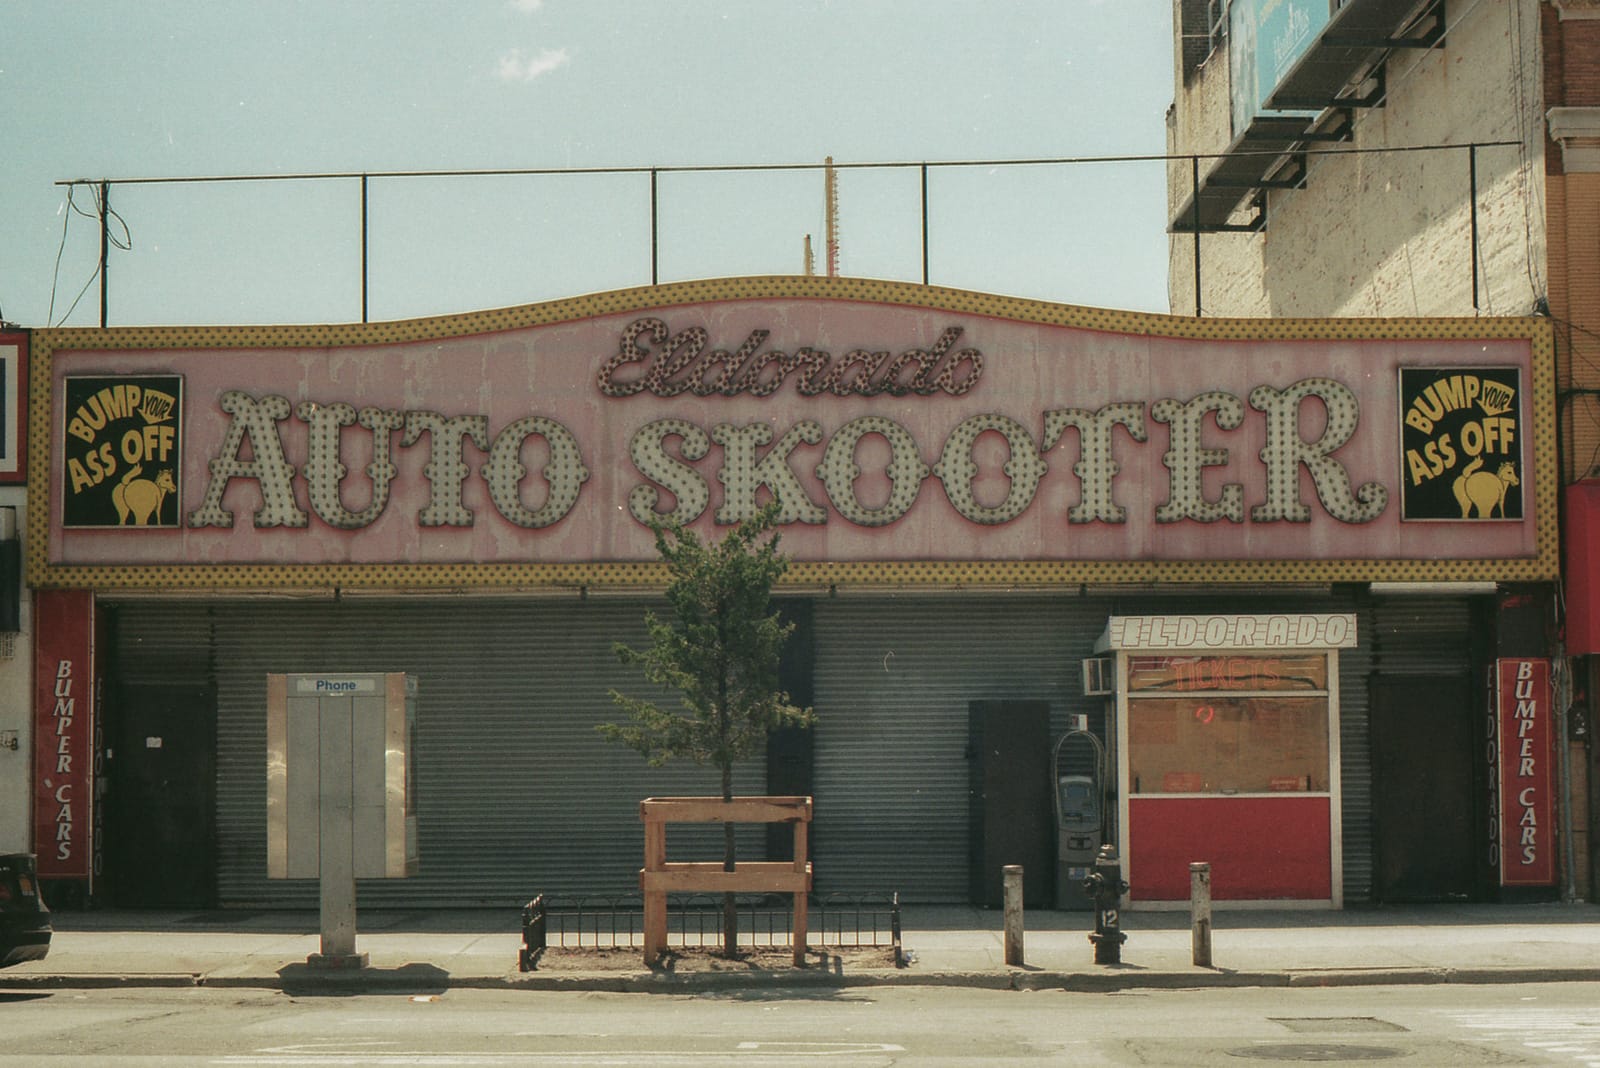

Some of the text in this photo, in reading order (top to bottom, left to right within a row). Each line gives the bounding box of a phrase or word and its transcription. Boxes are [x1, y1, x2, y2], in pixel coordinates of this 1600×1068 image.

[598, 317, 984, 397] Eldorado
[68, 385, 172, 443] BUMP YOUR
[1405, 375, 1510, 435] BUMP YOUR
[68, 425, 175, 494] ASS OFF
[188, 377, 1389, 528] AUTO SKOOTER
[1406, 417, 1515, 487] ASS OFF
[1121, 615, 1348, 647] ELDORADO
[316, 680, 356, 690] Phone
[1171, 659, 1280, 690] TICKETS
[53, 660, 75, 860] BUMPER CARS
[1487, 665, 1498, 866] ELDORADO
[1514, 661, 1537, 865] BUMPER CARS
[1102, 910, 1118, 928] 12
